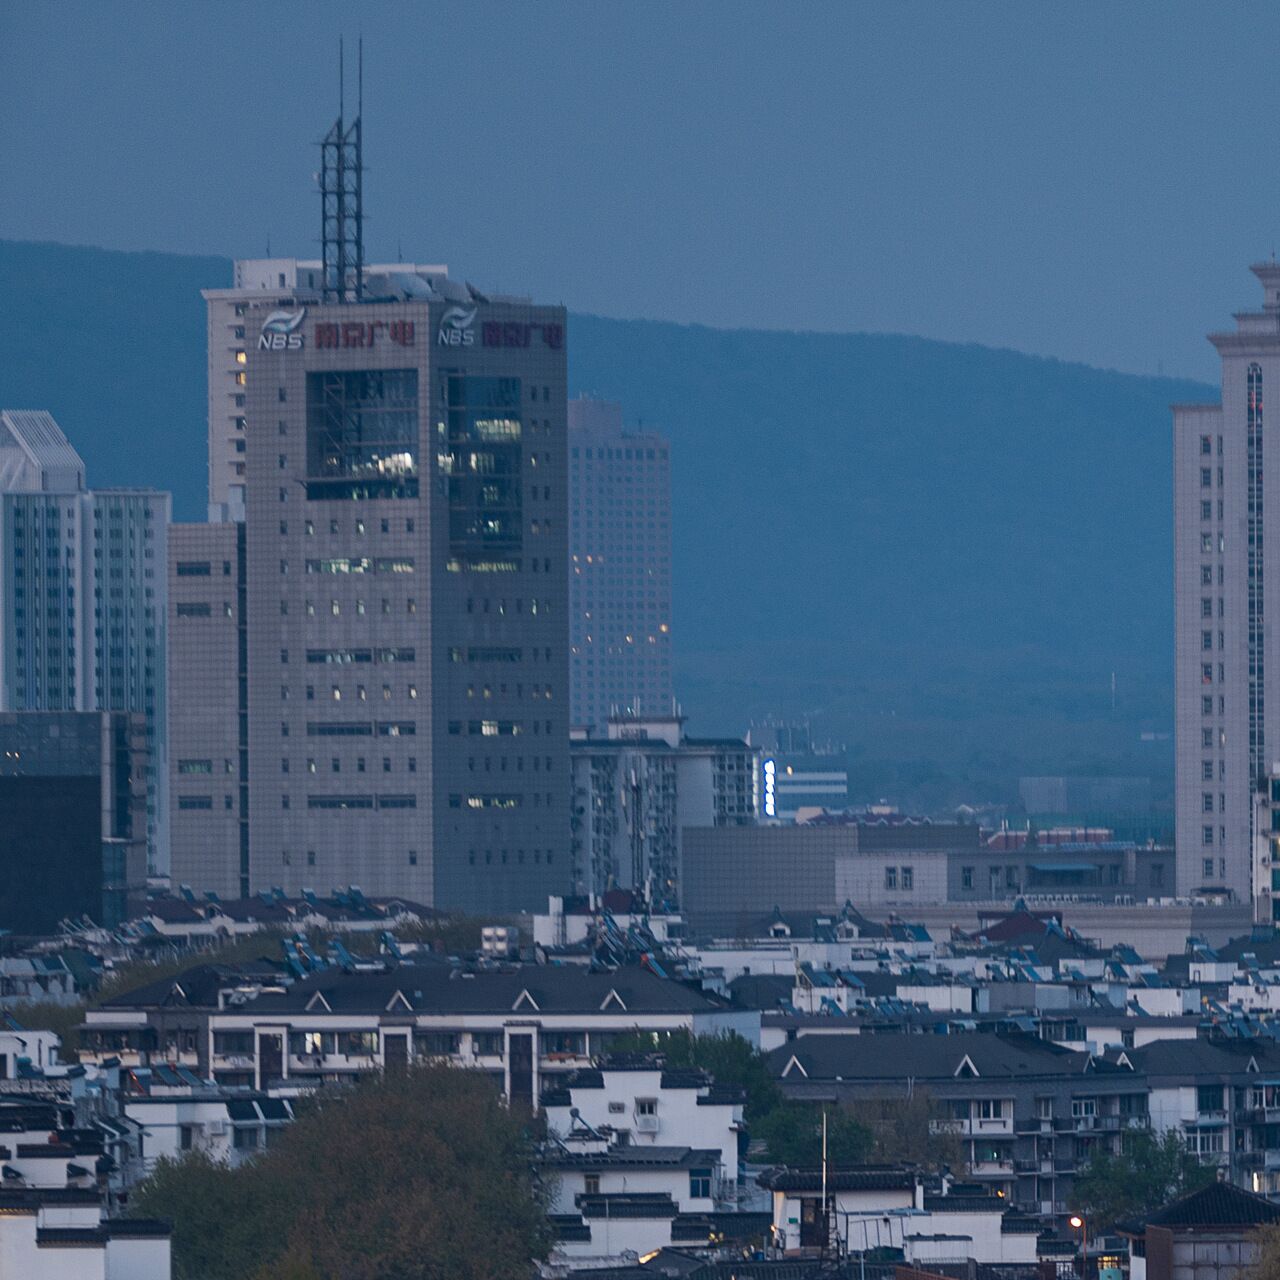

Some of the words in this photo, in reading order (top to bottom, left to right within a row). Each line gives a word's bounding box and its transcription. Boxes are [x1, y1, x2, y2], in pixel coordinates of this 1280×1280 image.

[257, 333, 303, 350] NBS
[314, 320, 415, 349] 南京广电
[438, 329, 474, 346] NBS
[482, 320, 564, 348] 南京广电
